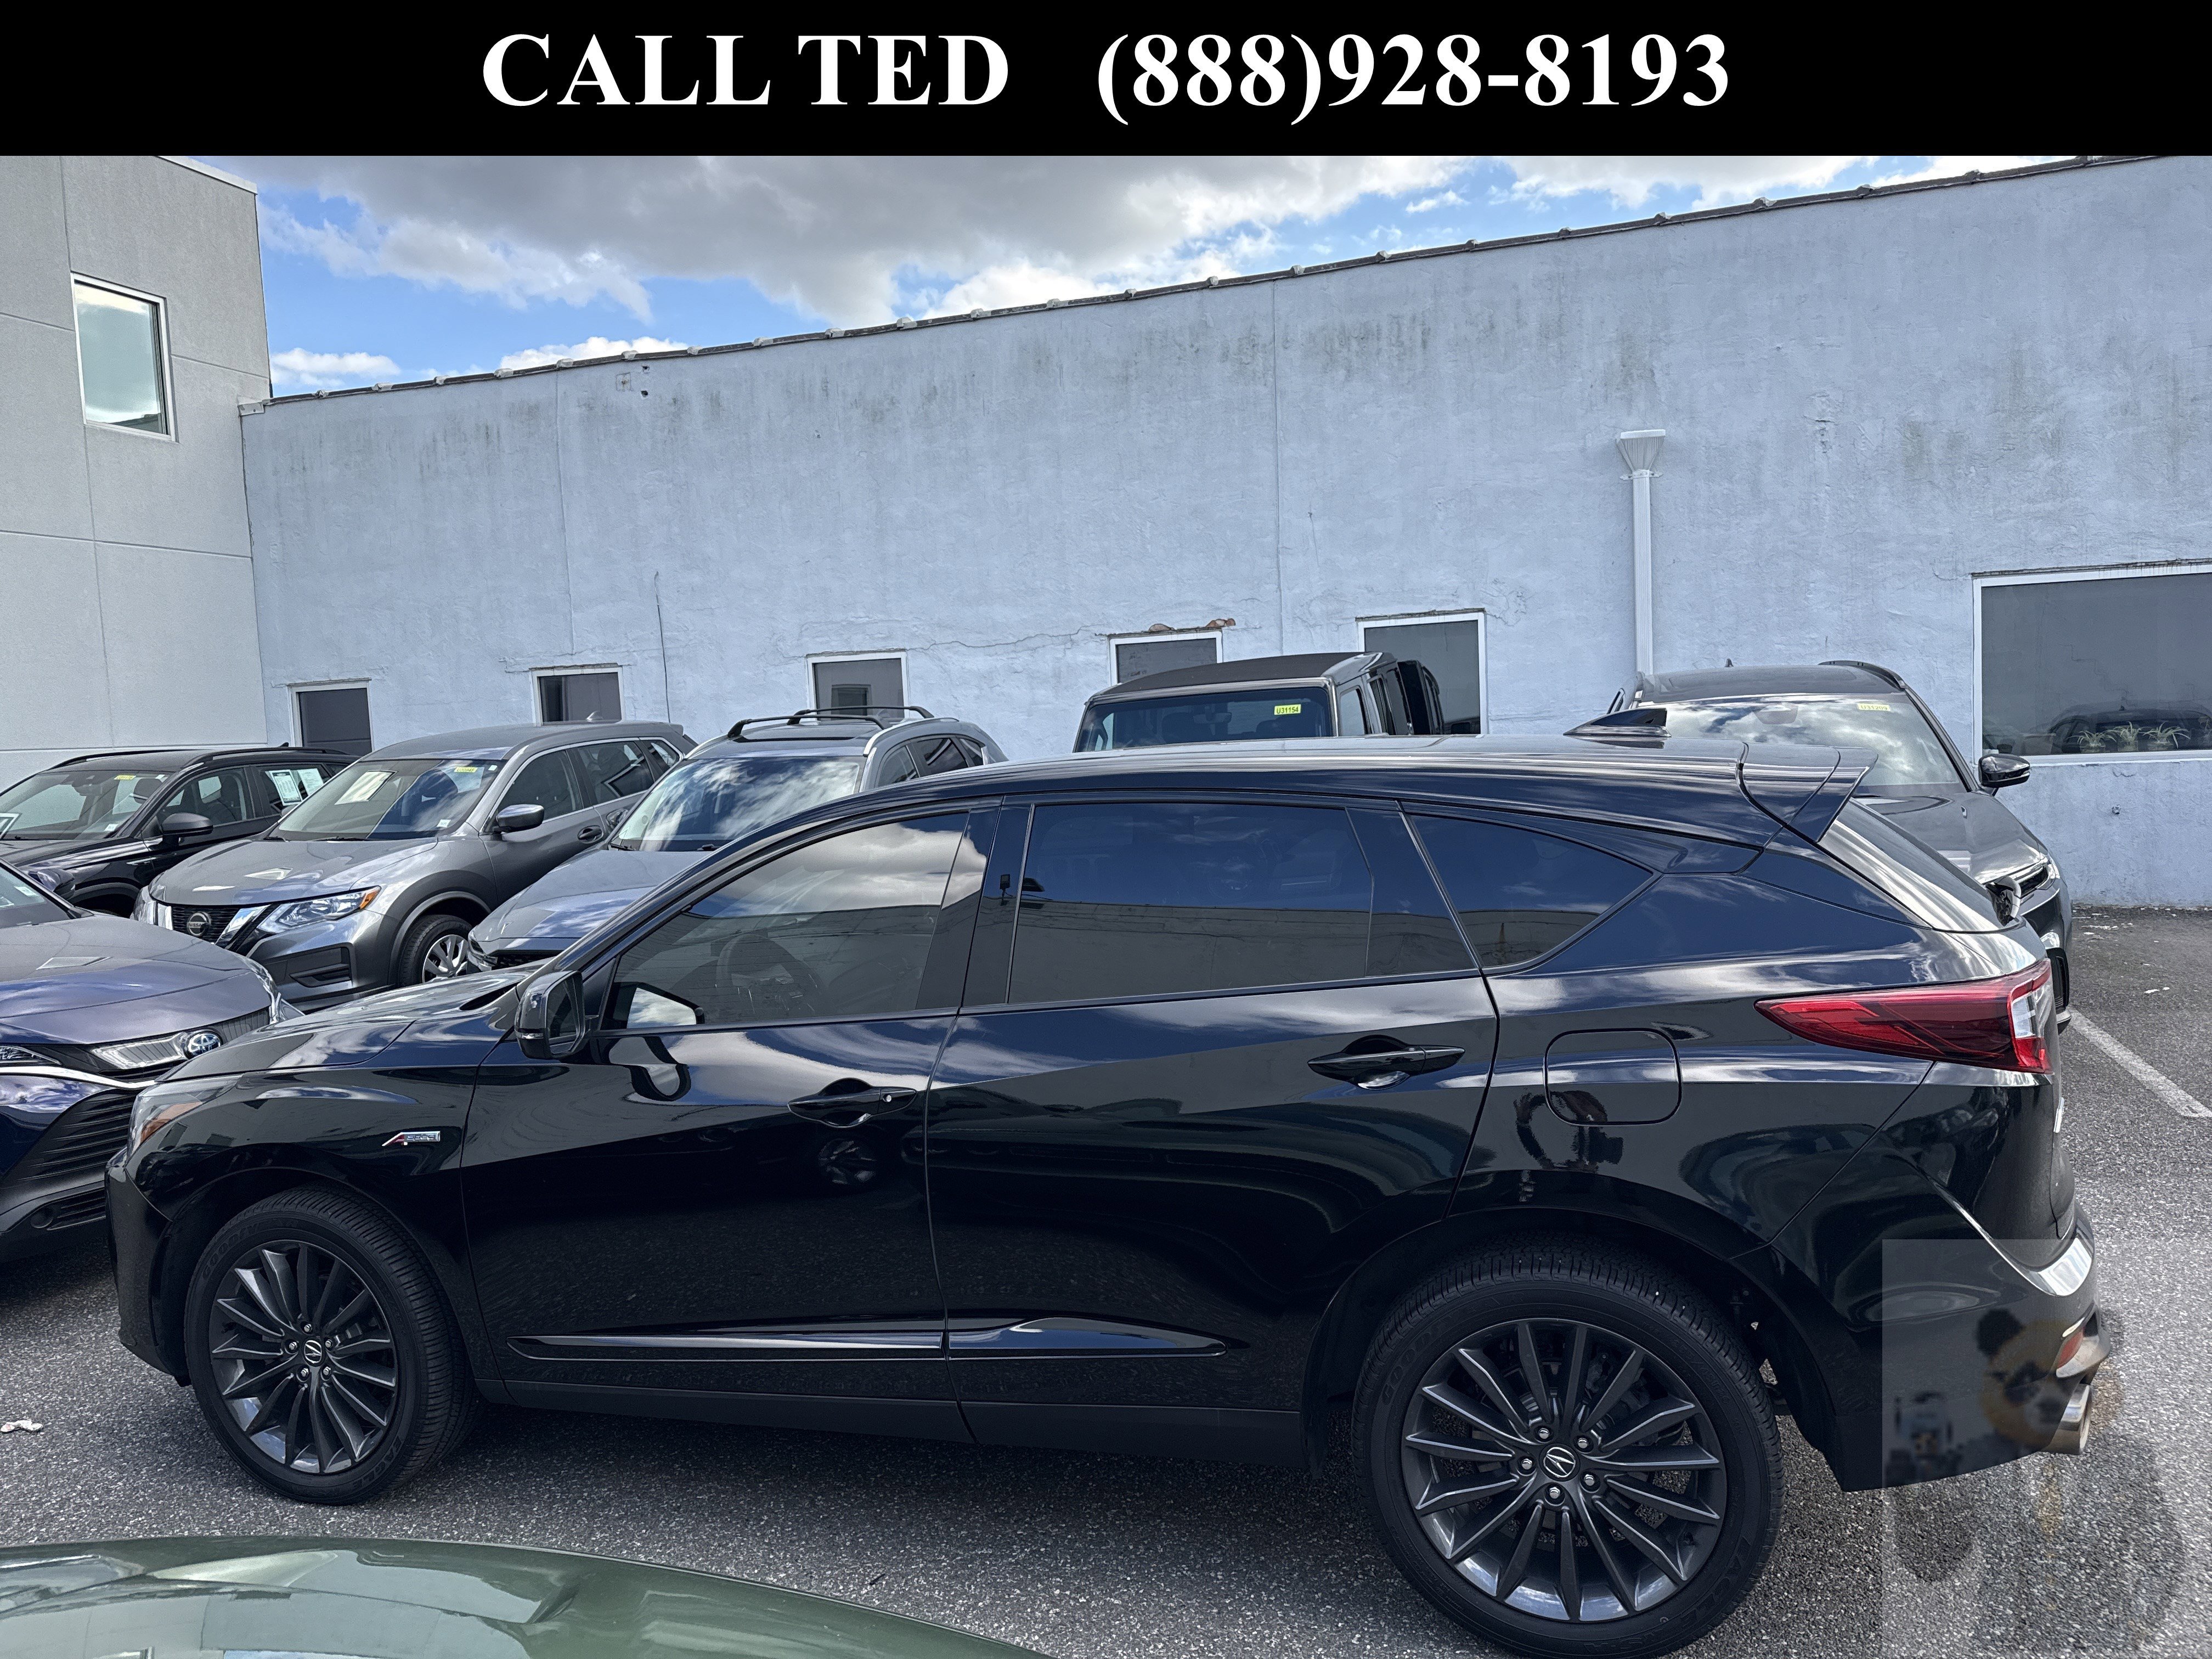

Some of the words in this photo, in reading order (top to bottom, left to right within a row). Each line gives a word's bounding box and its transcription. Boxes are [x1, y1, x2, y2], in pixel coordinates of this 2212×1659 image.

[1276, 706, 1299, 714] U31154
[202, 1218, 299, 1281] GOODYAR
[352, 1435, 403, 1488] EAGLE
[1680, 1536, 1752, 1627] EAGLE
